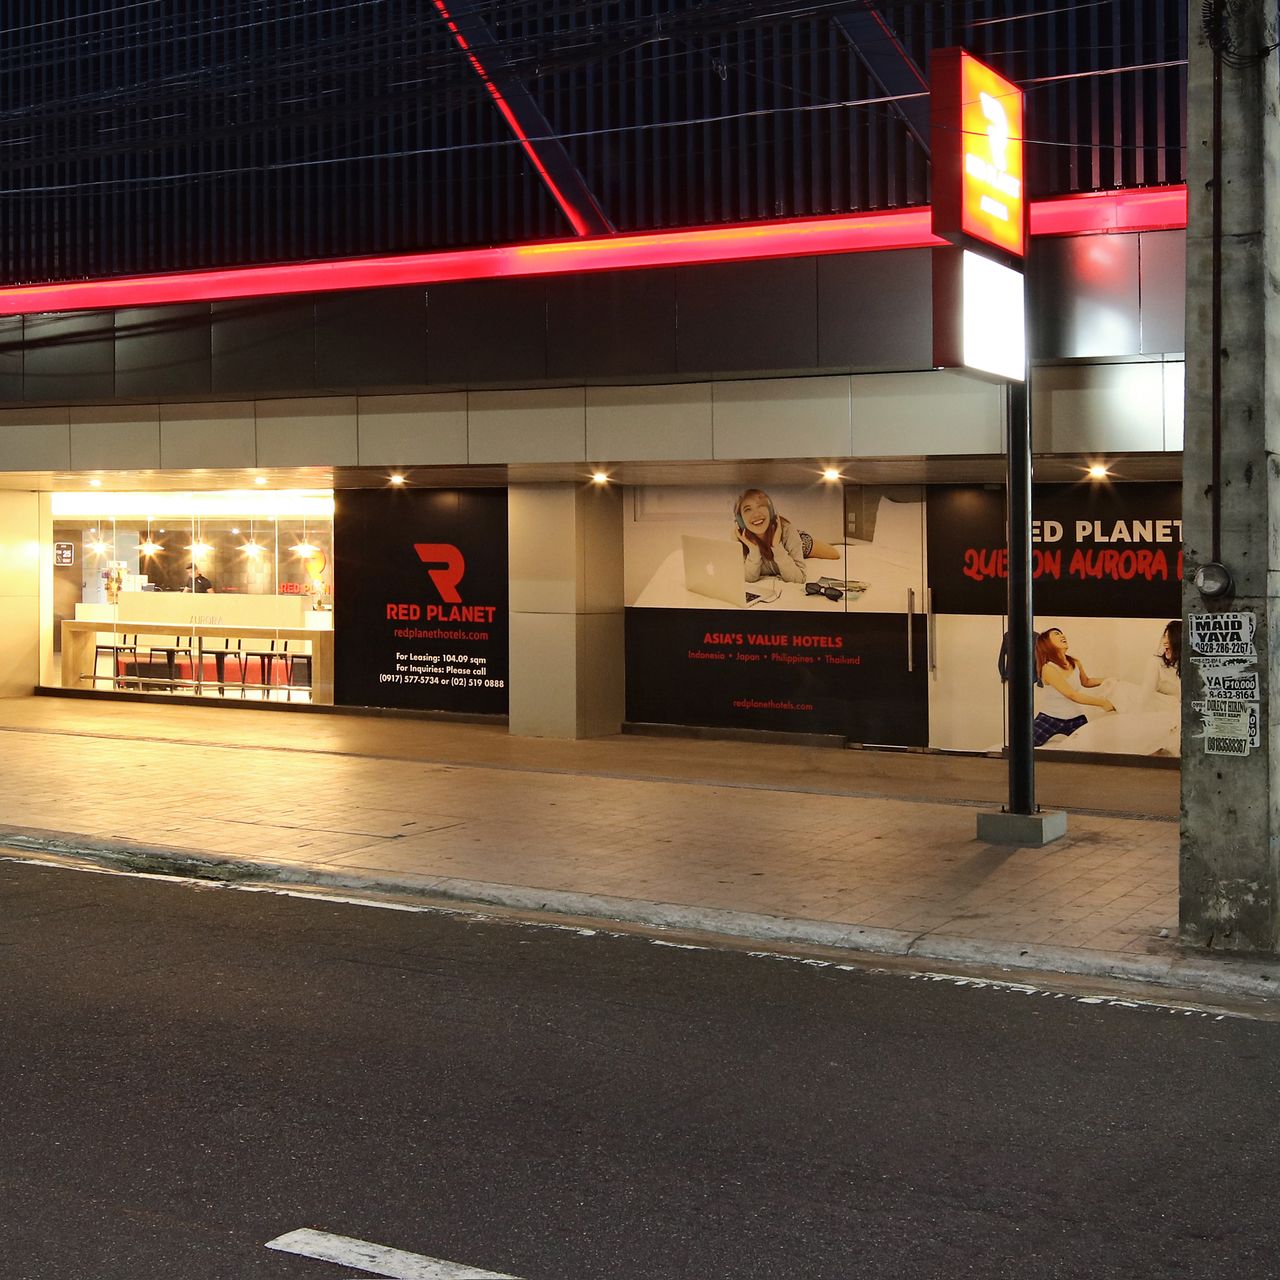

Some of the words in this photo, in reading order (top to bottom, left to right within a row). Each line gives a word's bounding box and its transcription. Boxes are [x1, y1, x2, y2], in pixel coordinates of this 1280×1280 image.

[1005, 520, 1064, 543] ED
[963, 548, 1062, 581] QUEON
[1069, 548, 1168, 581] AURORA
[280, 582, 300, 594] RED
[386, 603, 421, 620] RED
[426, 604, 497, 623] PLANET
[1195, 620, 1243, 632] MAID
[394, 627, 489, 641] redplanethotels.com
[703, 633, 743, 645] ASIA'S
[747, 634, 788, 646] VALUE
[793, 636, 843, 648] HOTELS
[1197, 631, 1243, 643] YAYA
[396, 652, 409, 661] For
[409, 653, 441, 664] Leasing:
[442, 654, 469, 663] 104.09
[470, 656, 487, 666] sqm
[688, 650, 726, 660] Indonesia
[736, 651, 761, 662] Japan
[771, 653, 814, 664] Philippines
[825, 655, 861, 665] Thailand
[396, 663, 409, 672] For
[409, 664, 445, 674] Inquiries:
[446, 666, 471, 675] Please
[472, 667, 487, 676] call
[379, 673, 403, 684] (0917)
[404, 675, 440, 685] 577-5734
[451, 677, 467, 687] (02)
[468, 678, 483, 687] 519
[484, 679, 505, 688] 0888
[732, 699, 813, 711] redplanethotels.com
